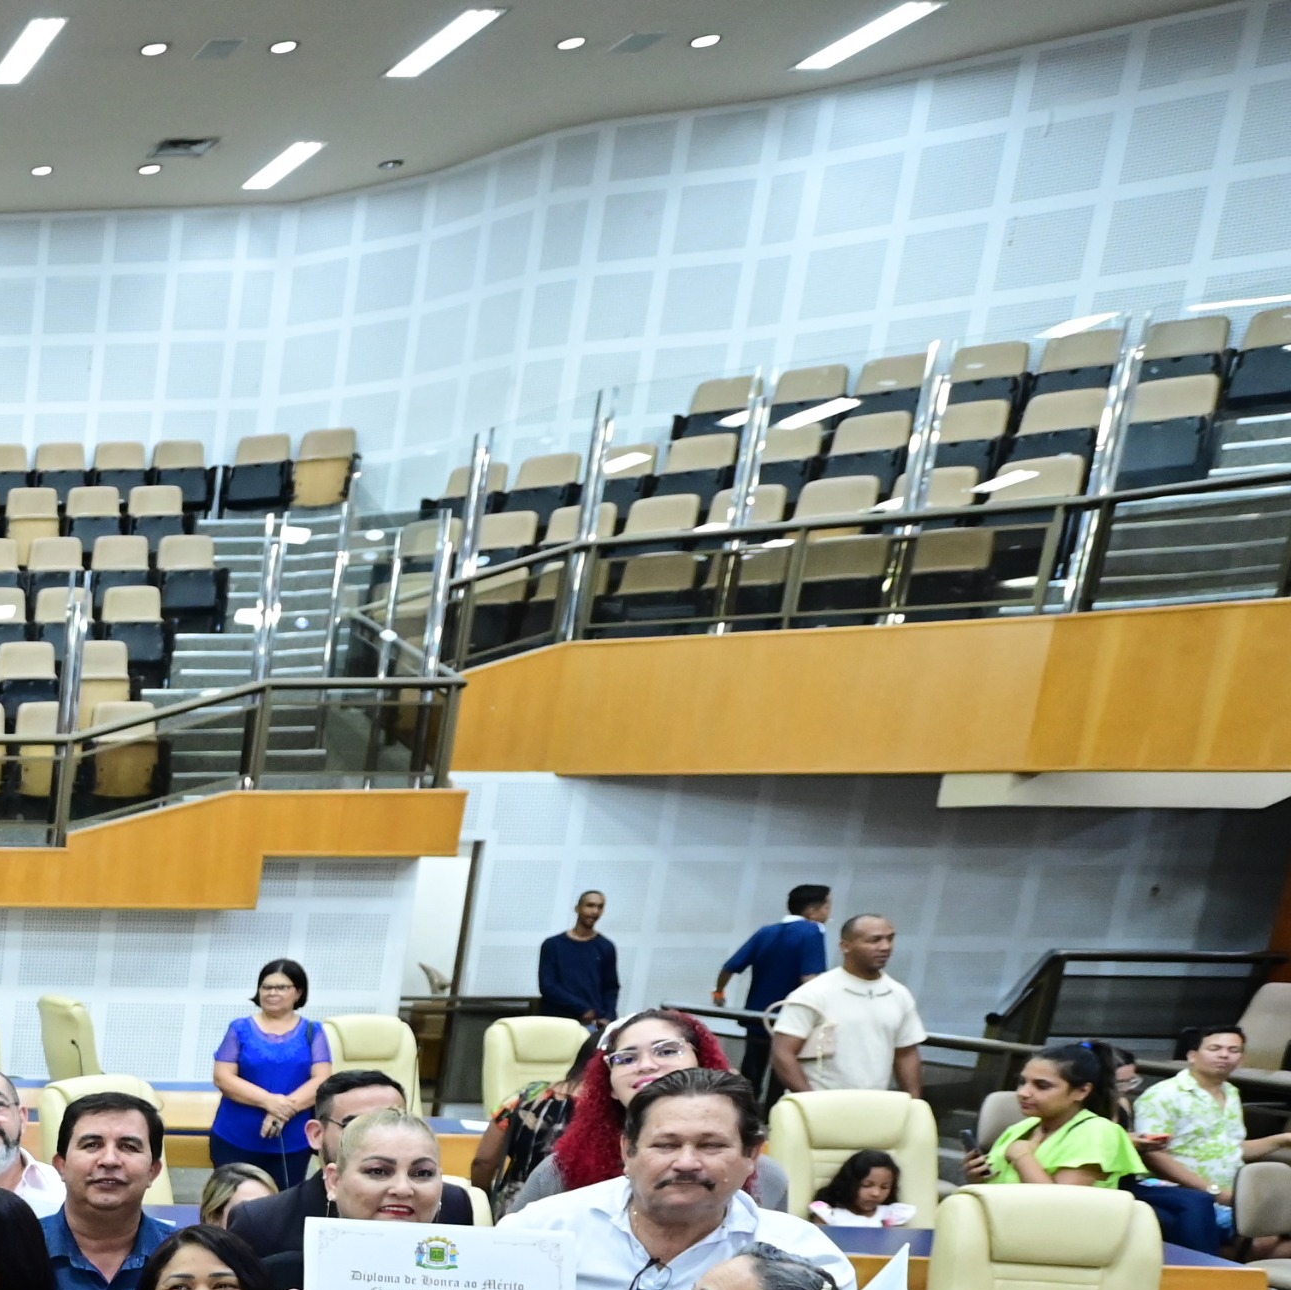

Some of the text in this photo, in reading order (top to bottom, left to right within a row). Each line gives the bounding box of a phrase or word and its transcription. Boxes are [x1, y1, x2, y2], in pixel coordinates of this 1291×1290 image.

[350, 1270, 400, 1284] Diploma
[404, 1274, 417, 1285] de
[421, 1274, 460, 1288] Honra
[463, 1280, 478, 1289] ao
